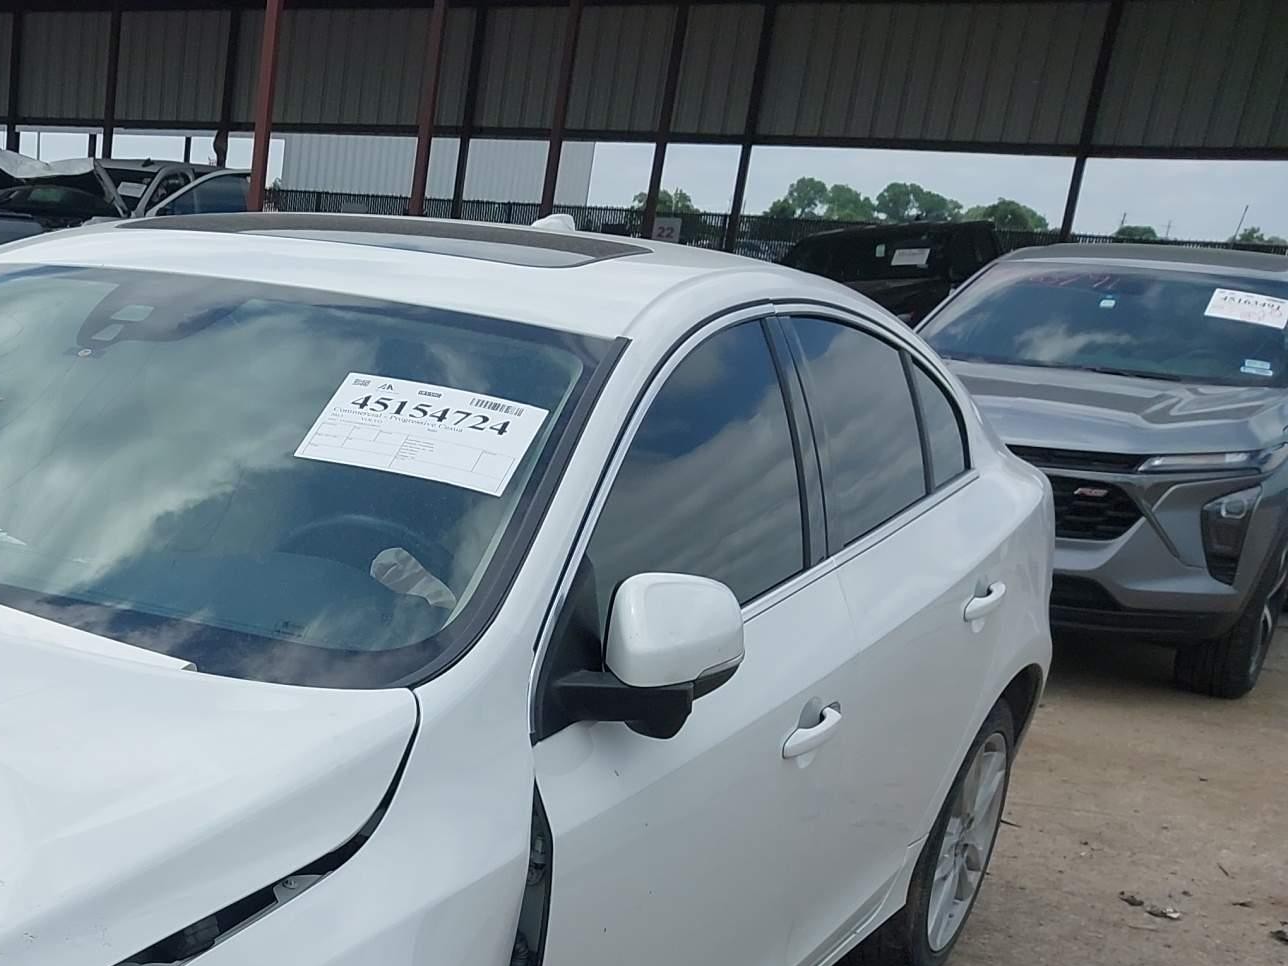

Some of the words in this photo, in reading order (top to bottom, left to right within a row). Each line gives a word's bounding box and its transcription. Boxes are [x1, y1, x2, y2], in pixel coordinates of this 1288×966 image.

[657, 226, 674, 239] 22
[351, 394, 511, 436] 45154724
[389, 415, 437, 429] Progressive
